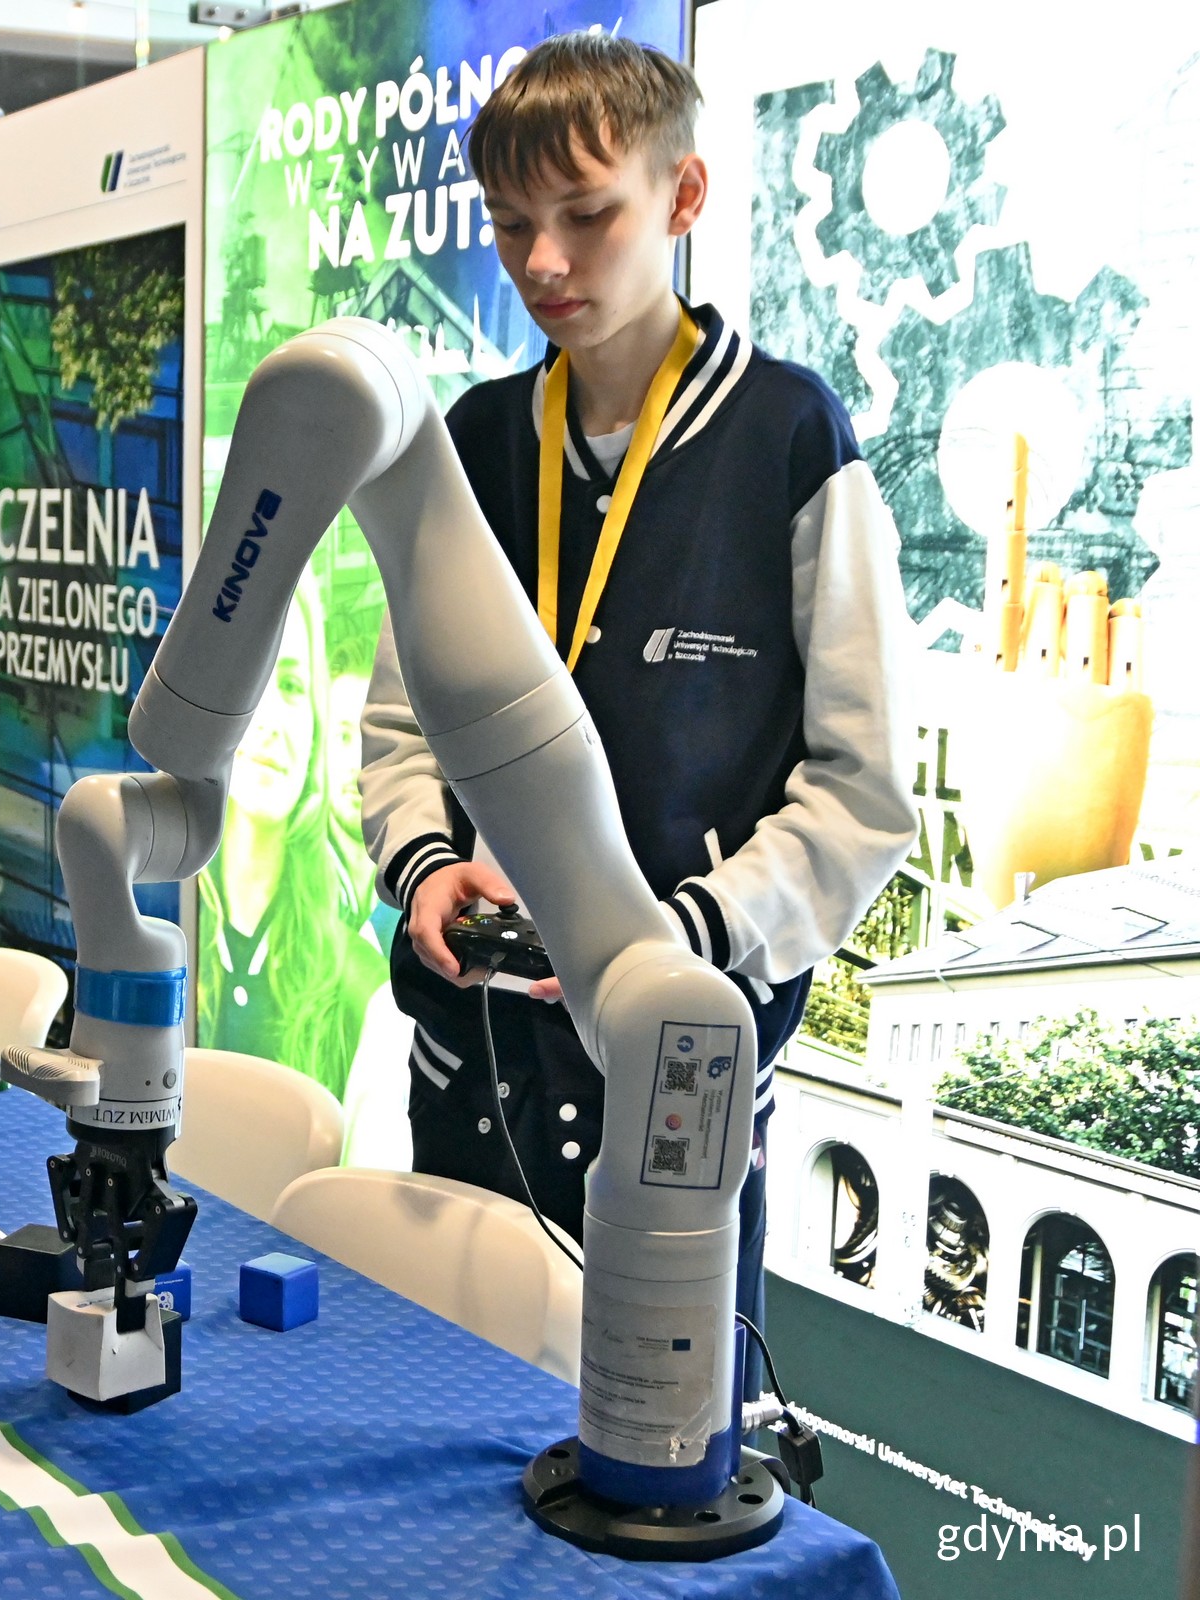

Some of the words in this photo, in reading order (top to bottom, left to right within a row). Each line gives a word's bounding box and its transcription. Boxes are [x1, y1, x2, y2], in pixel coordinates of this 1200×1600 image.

[259, 87, 368, 164] RODY
[308, 200, 375, 272] NA
[384, 179, 494, 260] ZUT!
[212, 488, 282, 624] KINOVA
[17, 576, 158, 639] ZIELONEGO
[93, 1108, 126, 1124] ZUT
[877, 1442, 968, 1499] Uniwersytet
[970, 1484, 1098, 1562] Technologiczny
